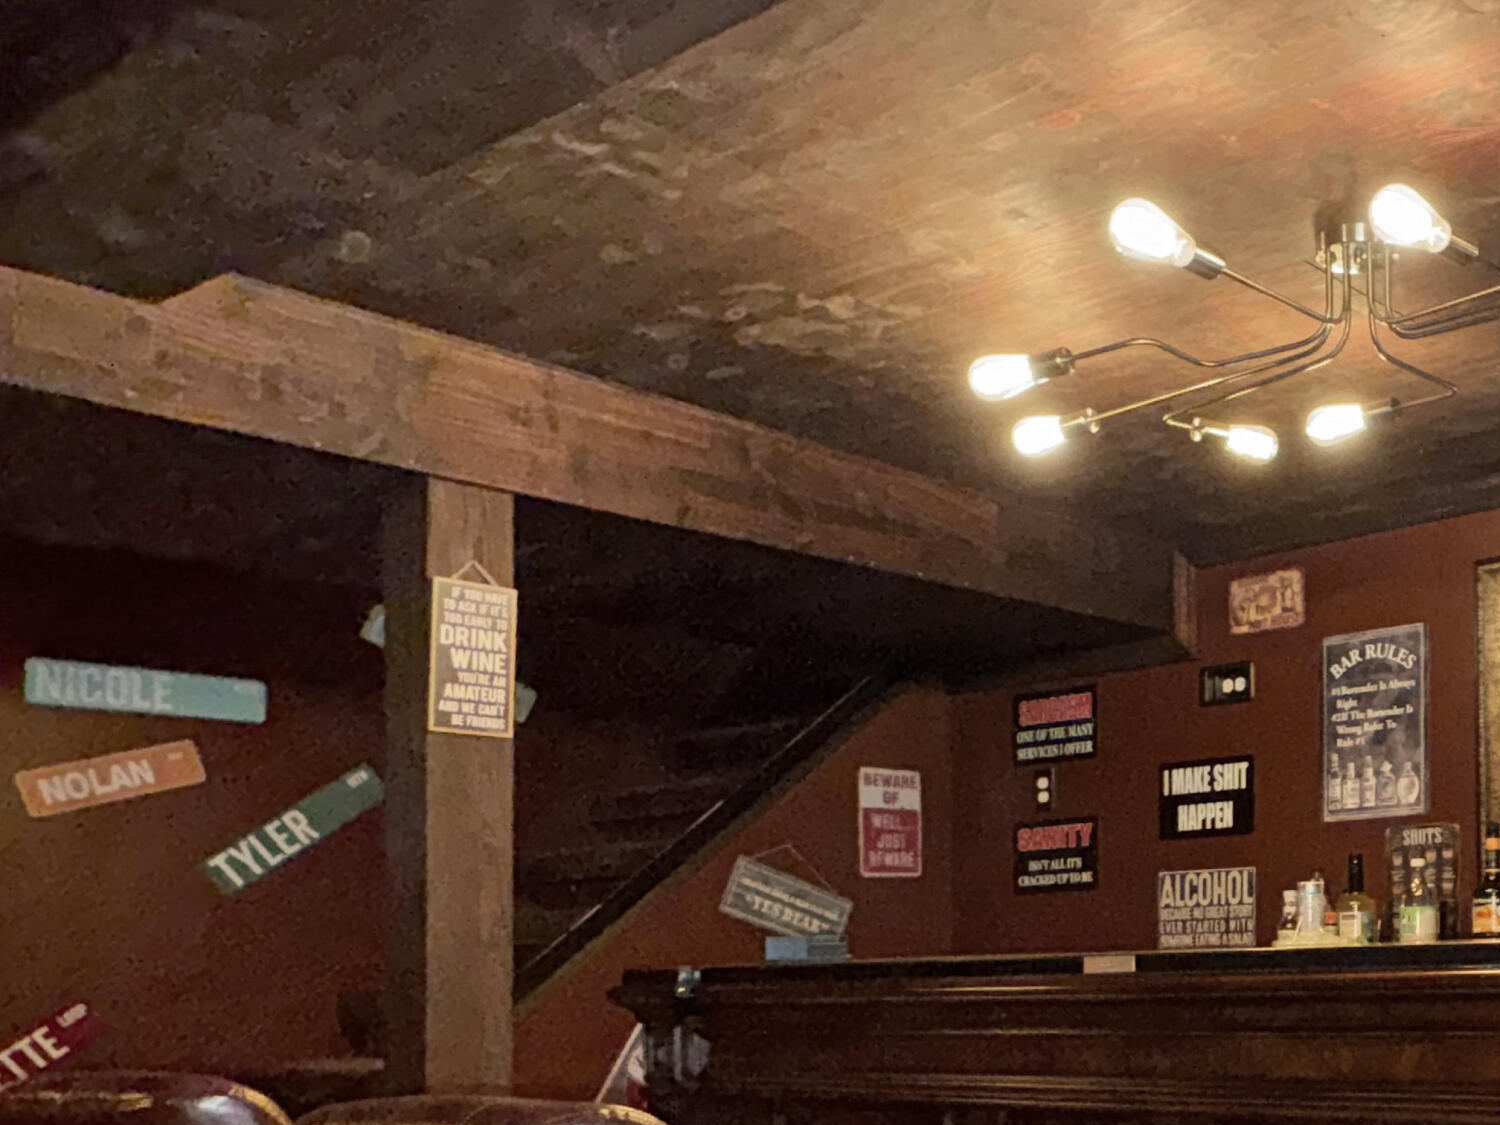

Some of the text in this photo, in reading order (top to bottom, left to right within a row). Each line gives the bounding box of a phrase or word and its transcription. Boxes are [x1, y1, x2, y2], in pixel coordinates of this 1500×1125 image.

[464, 614, 492, 629] EARLY
[440, 624, 508, 652] DRINK
[451, 647, 508, 675] WINE
[1329, 643, 1417, 680] BAR RULES
[34, 661, 174, 711] NICOLE
[443, 682, 506, 704] AMATEUR
[438, 699, 459, 713] AND
[461, 701, 475, 714] WE
[451, 714, 465, 726] BE
[37, 759, 156, 805] NOLAN
[863, 772, 918, 790] BEWARE
[1163, 761, 1249, 797] I MAKE SHIT
[882, 790, 899, 805] OF
[1177, 800, 1234, 832] HAPPEN
[207, 810, 320, 888] TYLER
[877, 833, 906, 849] JUST
[1402, 827, 1443, 846] SHOTS
[869, 851, 915, 868] BEWARE
[1161, 870, 1254, 908] ALCOHOL
[1160, 918, 1254, 934] EVER STARTED WITH
[0, 1025, 70, 1091] TTE
